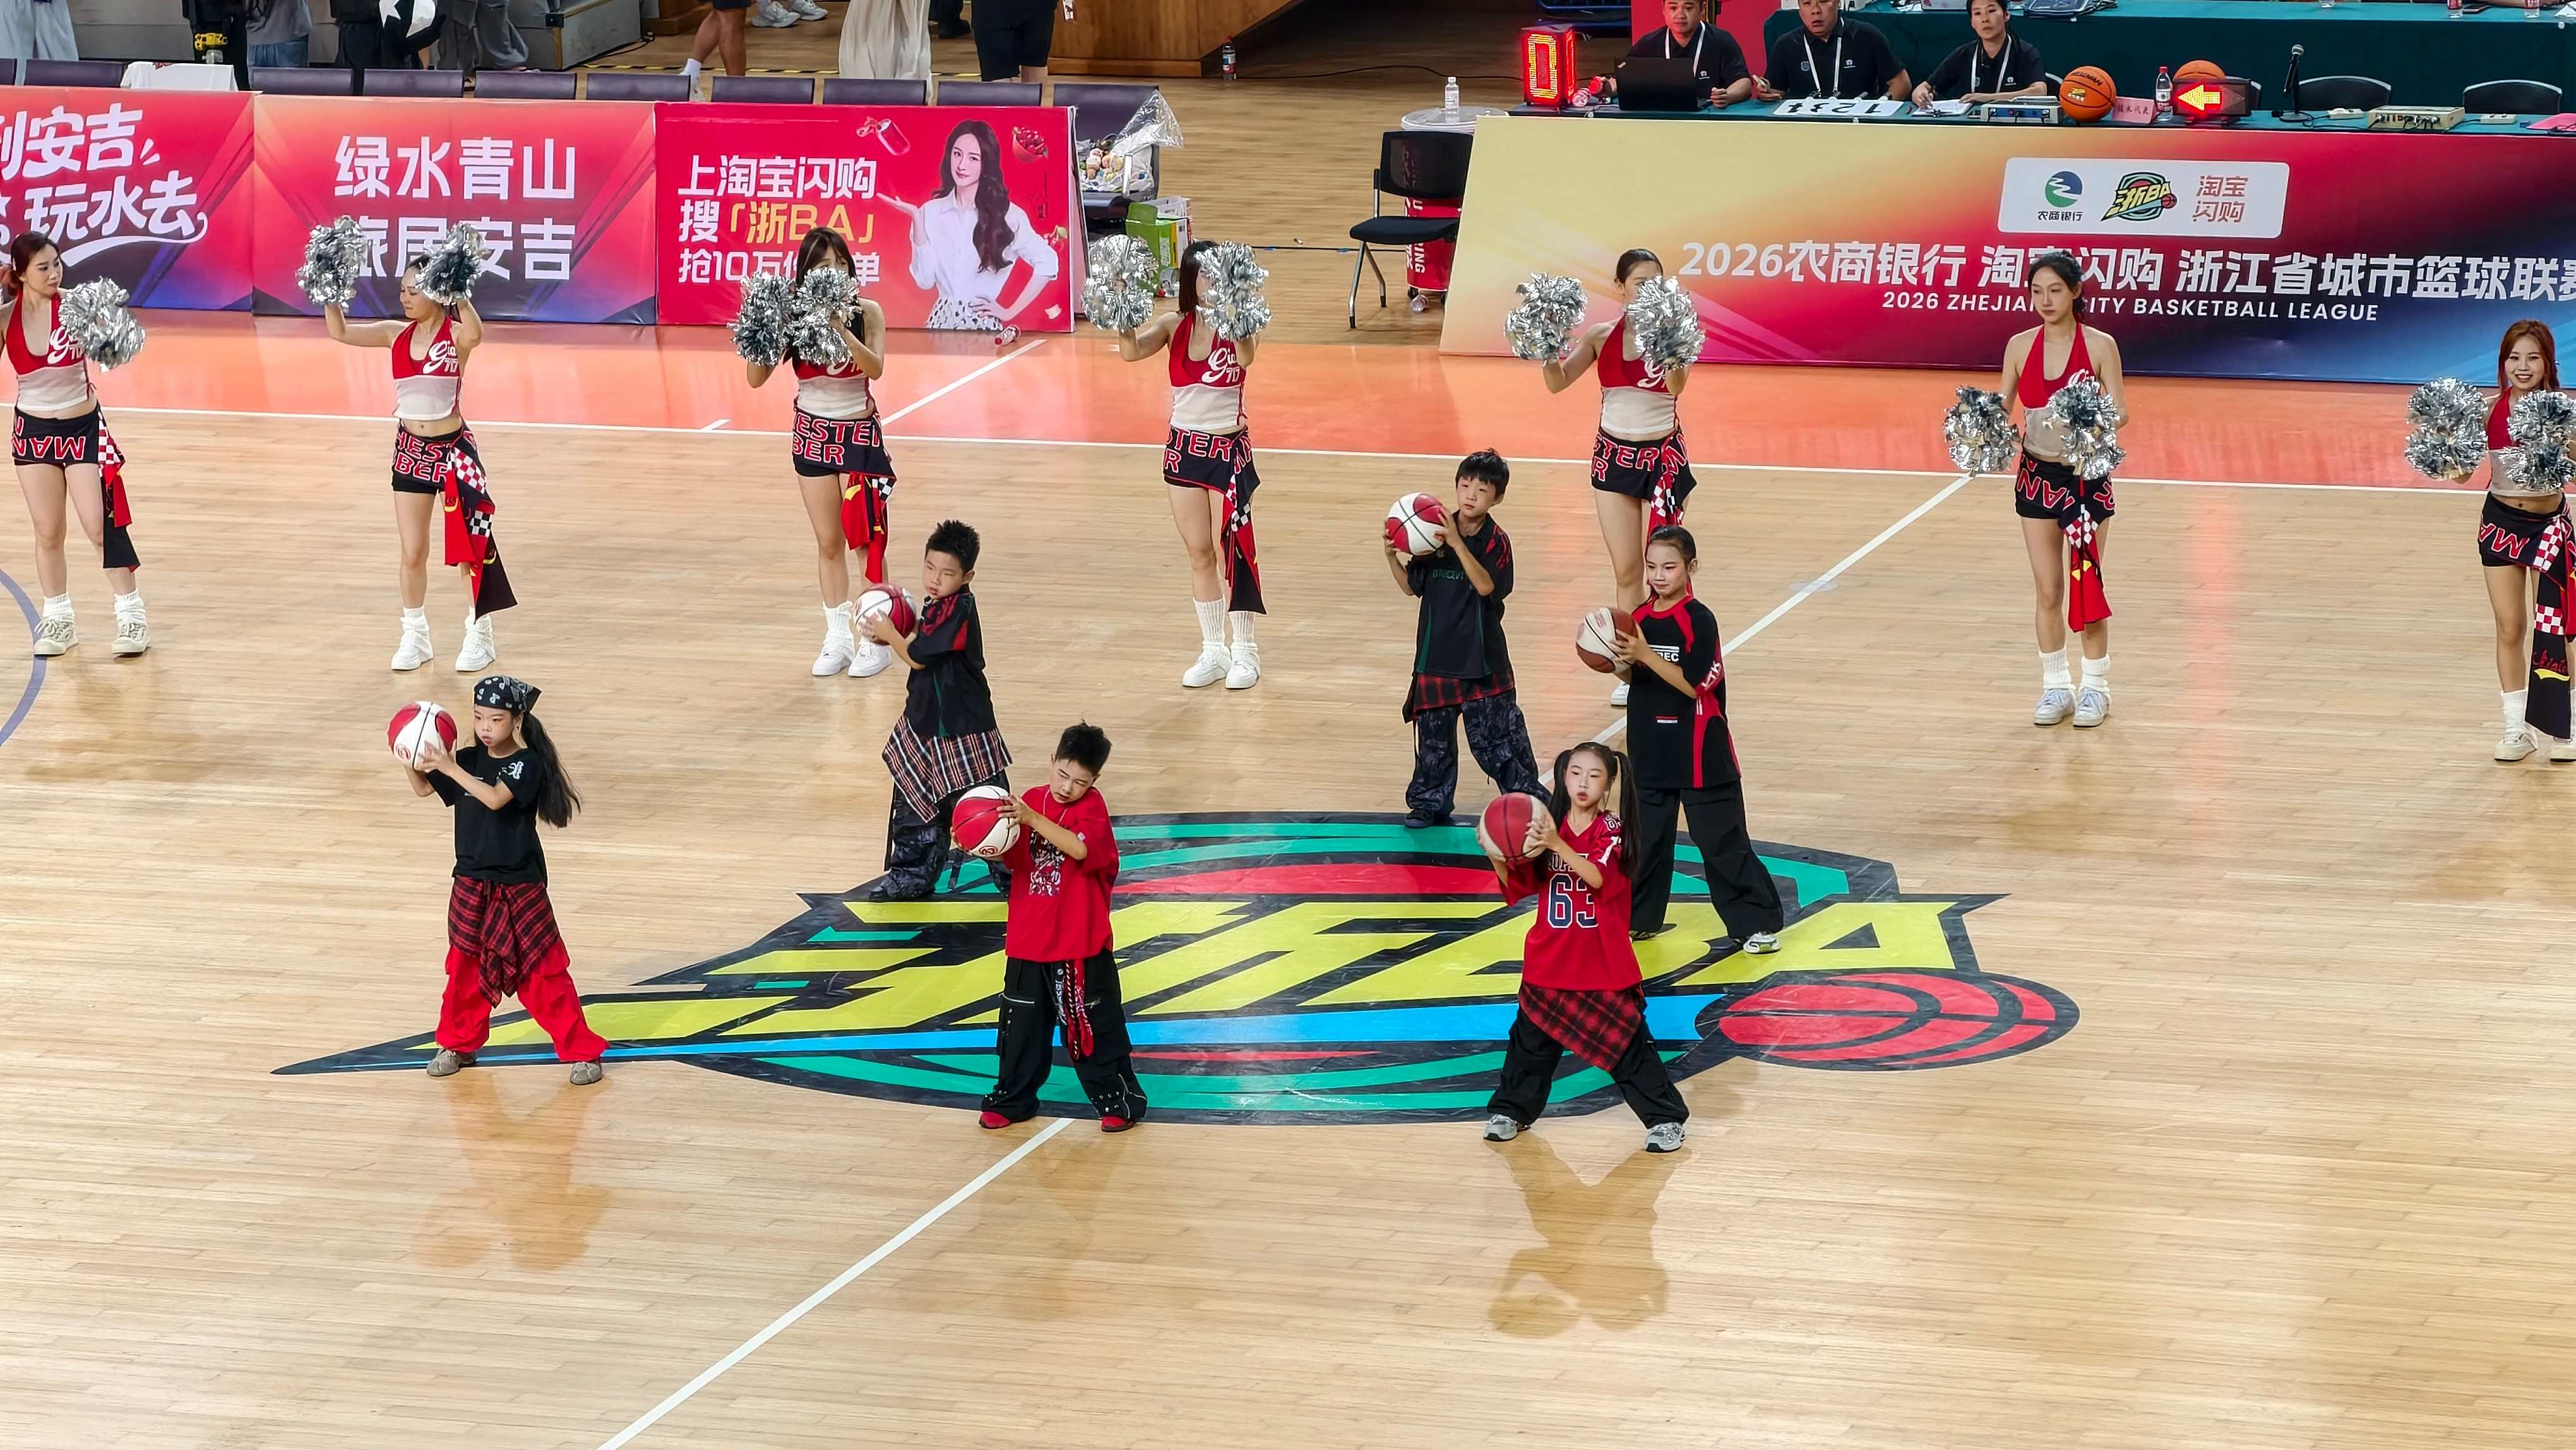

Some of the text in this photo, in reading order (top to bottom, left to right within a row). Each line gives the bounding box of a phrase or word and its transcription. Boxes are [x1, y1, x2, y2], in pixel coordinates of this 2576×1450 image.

[335, 135, 575, 200] 绿水青山
[677, 155, 877, 199] 上淘宝闪购
[2196, 174, 2249, 198] 淘宝
[2037, 210, 2084, 222] 农商银行
[2192, 200, 2246, 223] 闪购
[1678, 240, 1967, 287] 2026农商银行
[1977, 245, 2164, 291] 淘闪购
[1882, 291, 2379, 321] 2026 ZHEJIA ITY BASKETBALL LEAGUE
